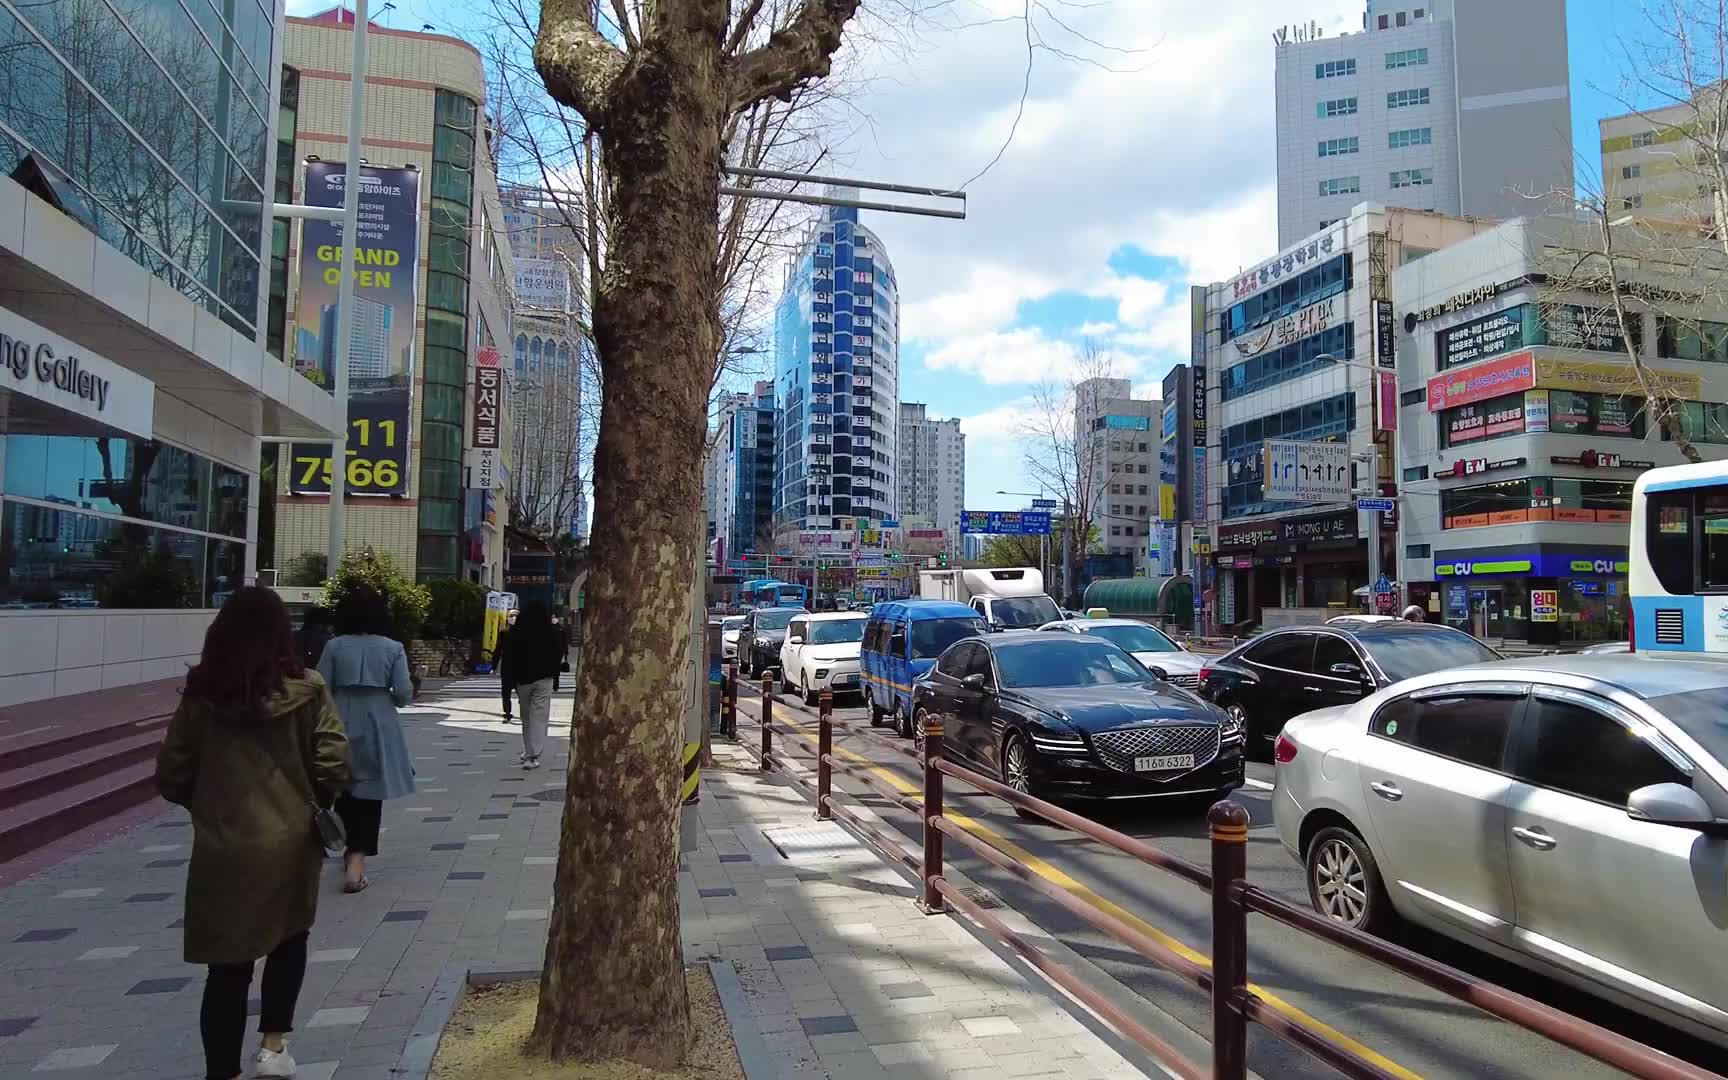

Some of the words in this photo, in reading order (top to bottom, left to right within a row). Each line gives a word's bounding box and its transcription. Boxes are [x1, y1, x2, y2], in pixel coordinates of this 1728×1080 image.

[323, 268, 391, 288] OEN
[1300, 306, 1313, 324] PT
[35, 343, 110, 411] Gallery
[477, 369, 498, 444] 동서식품
[1465, 458, 1487, 474] GYM
[1597, 453, 1621, 468] GYM
[1299, 521, 1320, 534] MONG
[1333, 520, 1344, 531] AE
[1454, 562, 1471, 575] CU
[1594, 559, 1614, 573] CU
[1533, 591, 1556, 606] 임대
[1167, 756, 1191, 767] 6322
